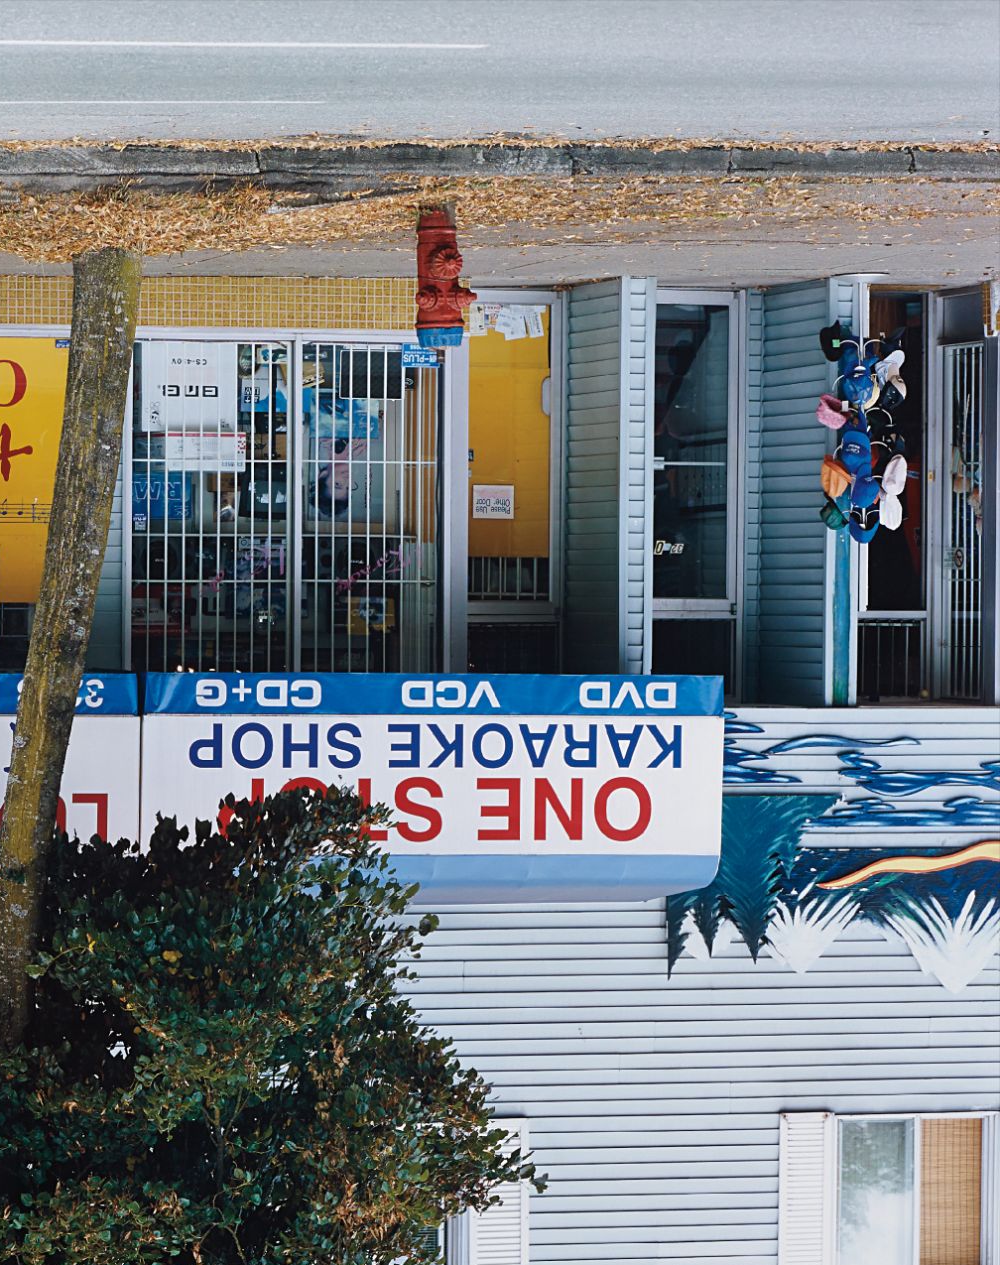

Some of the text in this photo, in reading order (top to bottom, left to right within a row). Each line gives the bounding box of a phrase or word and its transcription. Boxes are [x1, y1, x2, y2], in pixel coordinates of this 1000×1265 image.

[171, 358, 208, 366] CS-40V
[475, 499, 491, 507] Door
[475, 506, 510, 515] Please Use
[195, 678, 677, 709] DVD VCD CD+G
[187, 721, 684, 770] KARAOKE SHOP
[476, 776, 652, 842] ONE
